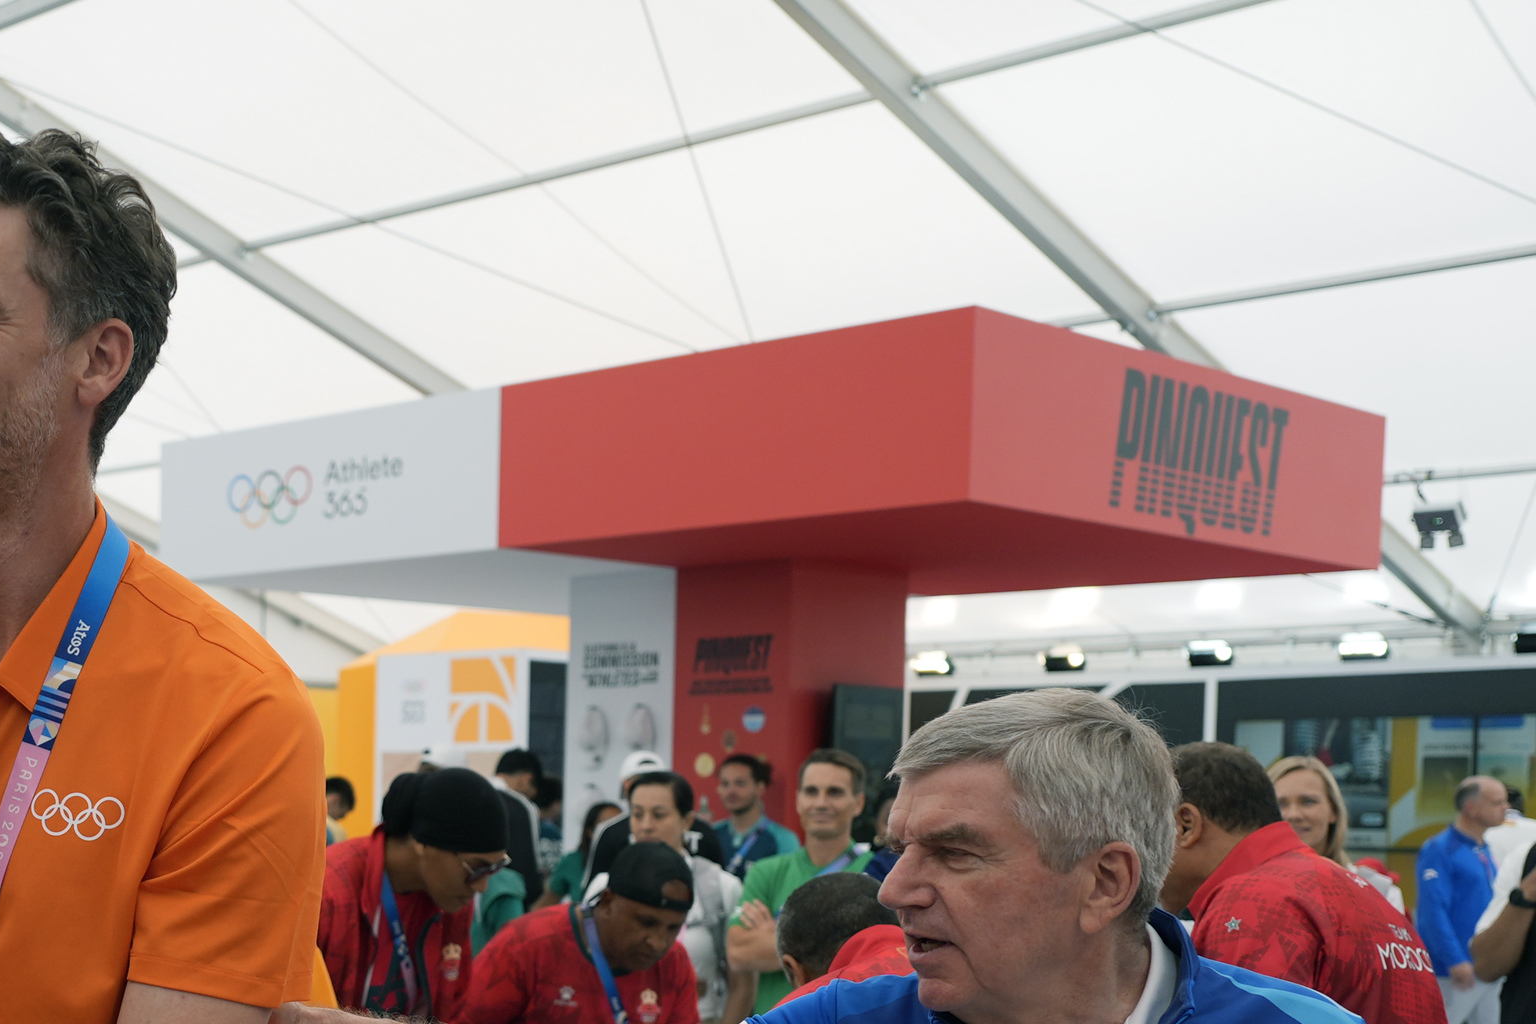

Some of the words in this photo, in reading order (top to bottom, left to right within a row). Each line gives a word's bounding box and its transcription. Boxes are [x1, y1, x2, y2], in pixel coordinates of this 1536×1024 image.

[323, 455, 404, 485] Athlete
[322, 487, 368, 518] 365
[67, 619, 91, 656] Atos
